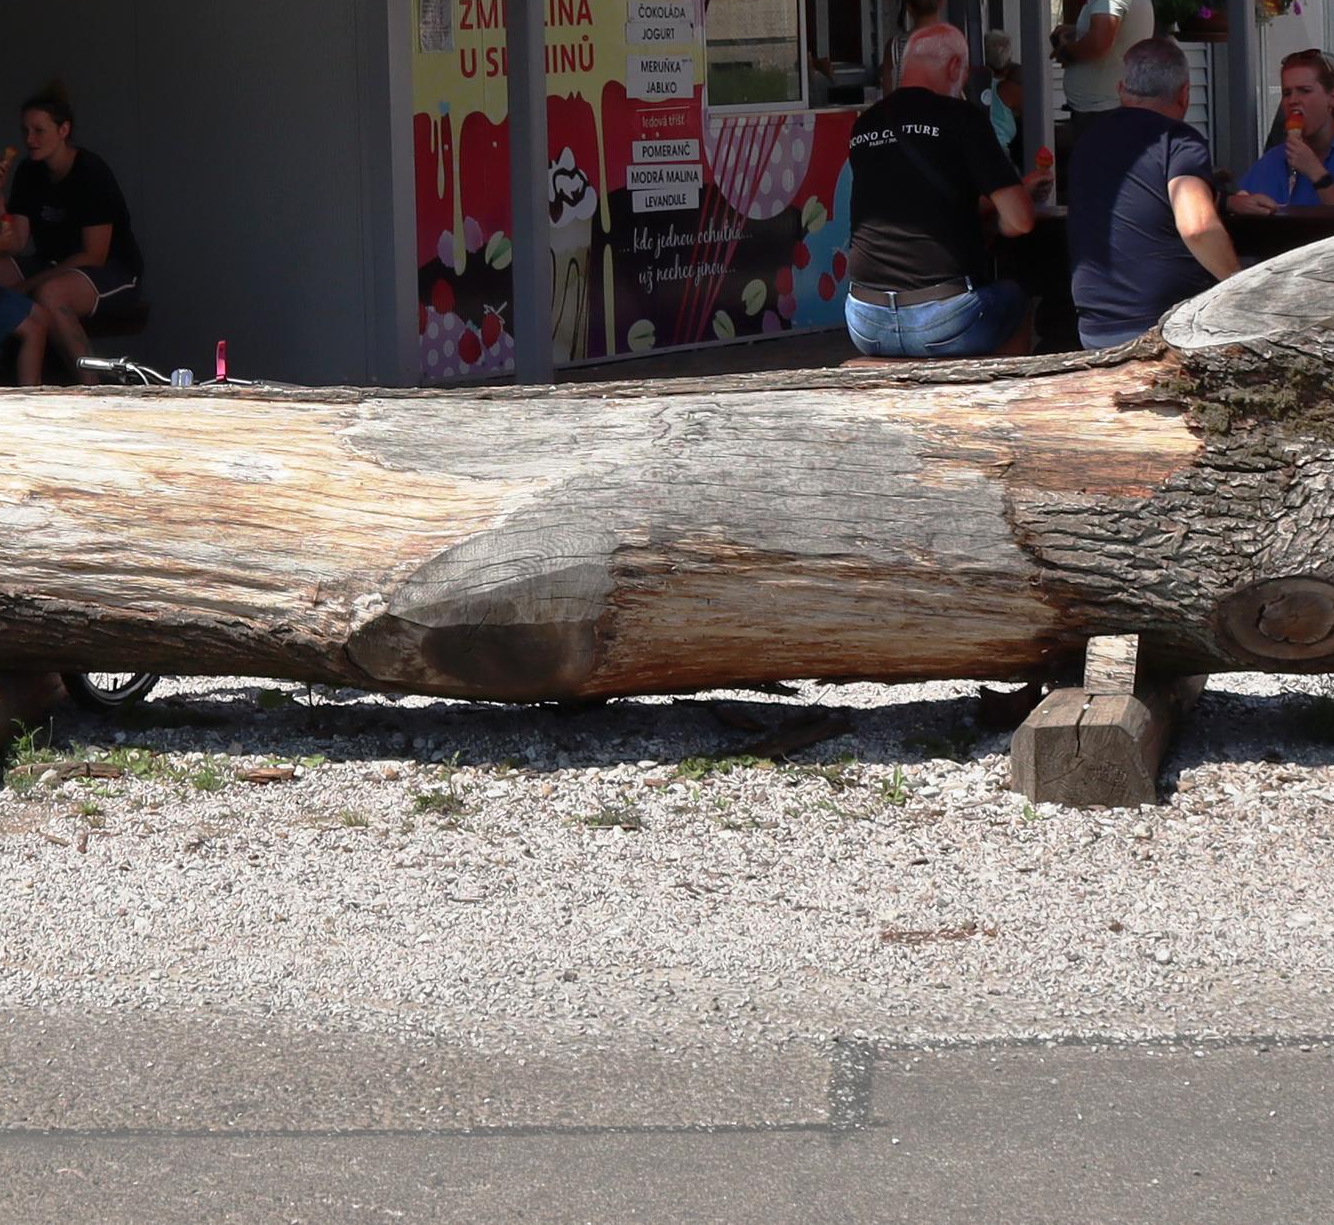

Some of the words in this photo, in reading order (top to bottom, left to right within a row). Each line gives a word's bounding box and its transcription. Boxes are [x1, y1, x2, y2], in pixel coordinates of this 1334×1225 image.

[638, 4, 686, 18] ČOKOLÁDA
[642, 28, 675, 40] JOGURT
[460, 48, 477, 78] U
[486, 34, 594, 78] SLINŮ
[641, 58, 681, 72] MERUŇKA
[646, 82, 677, 94] JABLKO
[642, 142, 690, 157] POMERANČ
[631, 170, 664, 184] MODRÁ
[667, 170, 699, 183] MALINA
[645, 194, 687, 207] LEVANDULE
